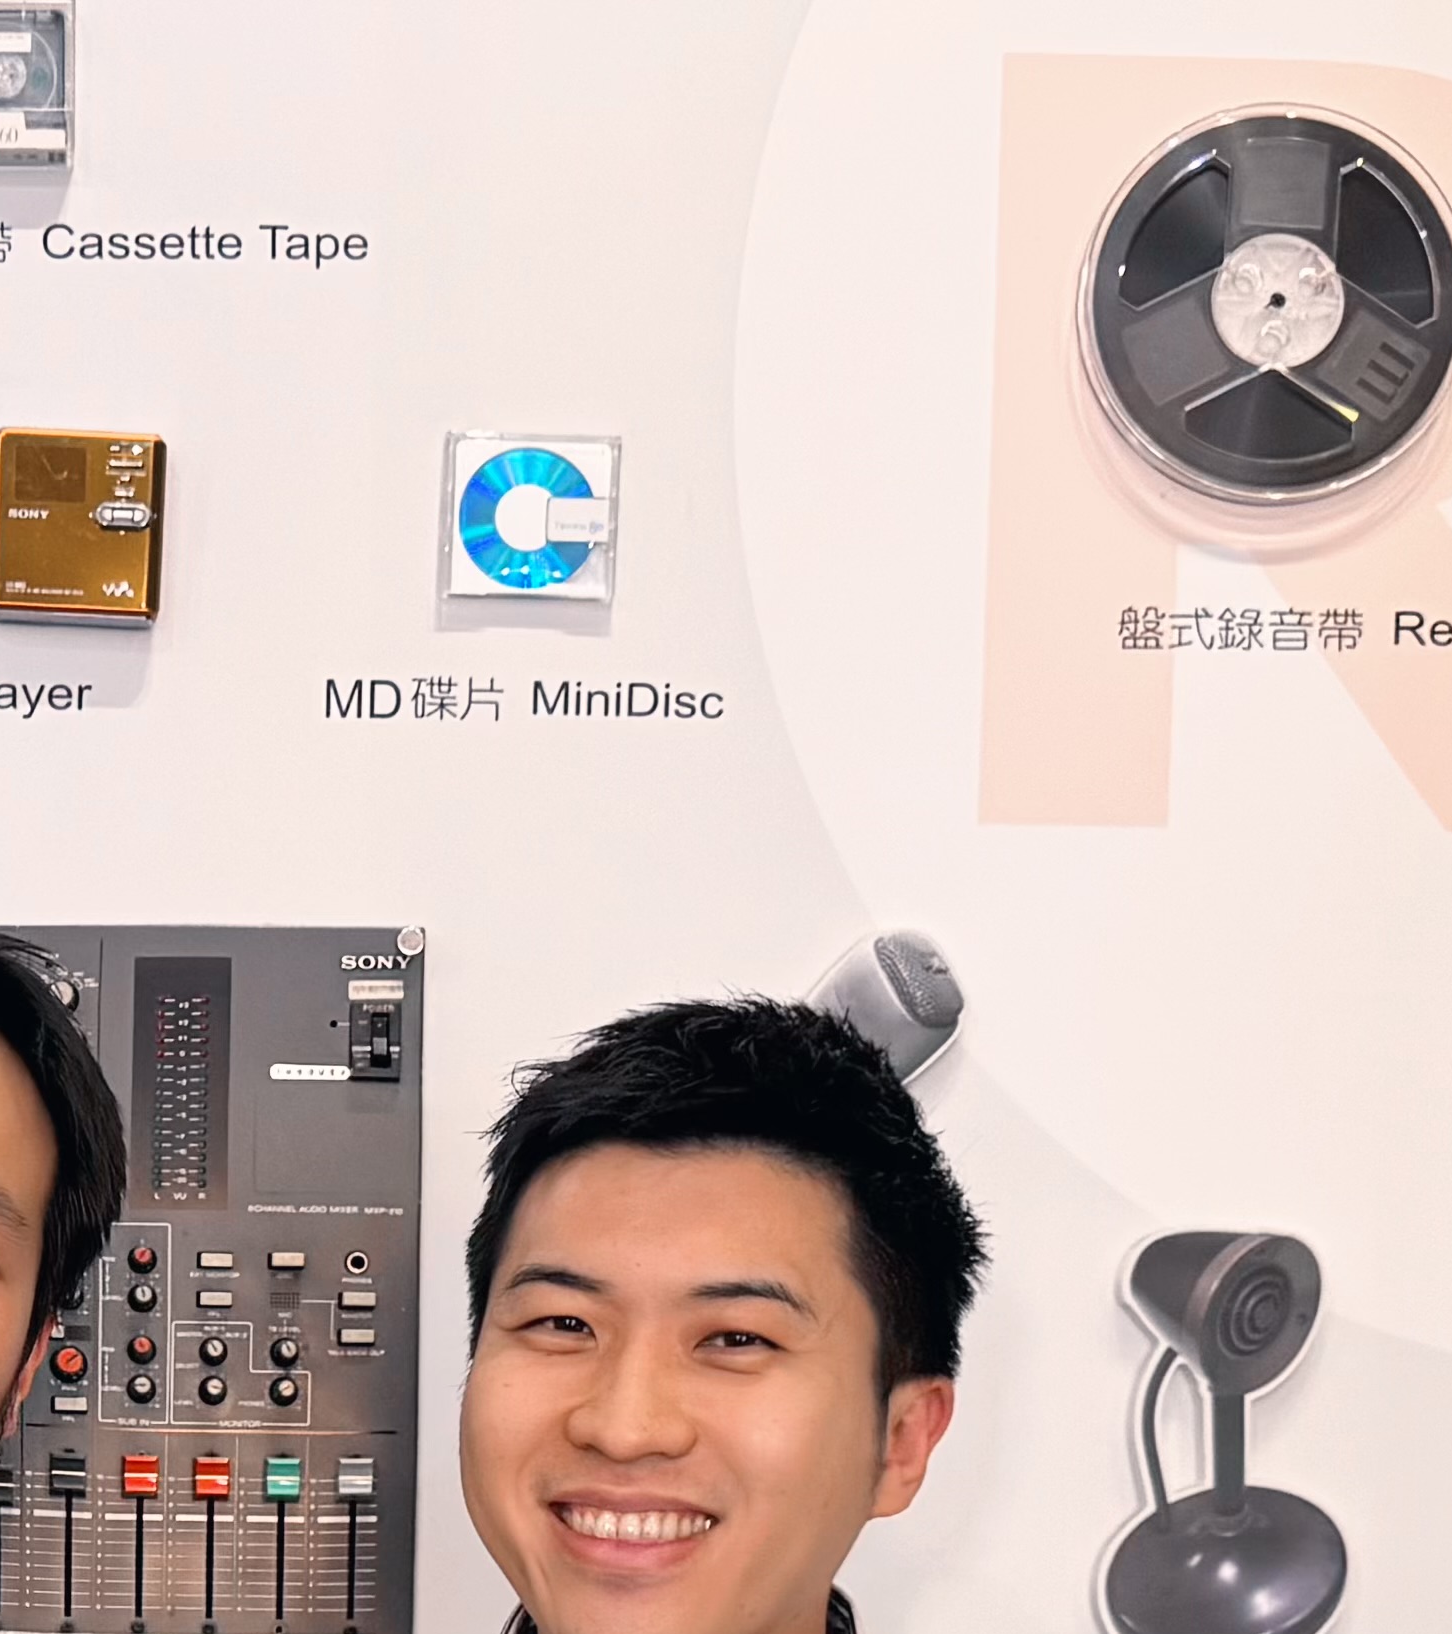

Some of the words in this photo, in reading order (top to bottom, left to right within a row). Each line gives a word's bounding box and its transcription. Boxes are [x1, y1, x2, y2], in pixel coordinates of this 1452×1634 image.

[0, 127, 19, 145] 60
[43, 223, 242, 260] Cassette
[259, 224, 368, 270] Tape
[8, 507, 50, 520] SONY
[1118, 606, 1363, 652] 盤式錄音帶
[532, 680, 723, 719] MiniDisc
[341, 955, 411, 970] SONY
[298, 1204, 327, 1214] AUDIO
